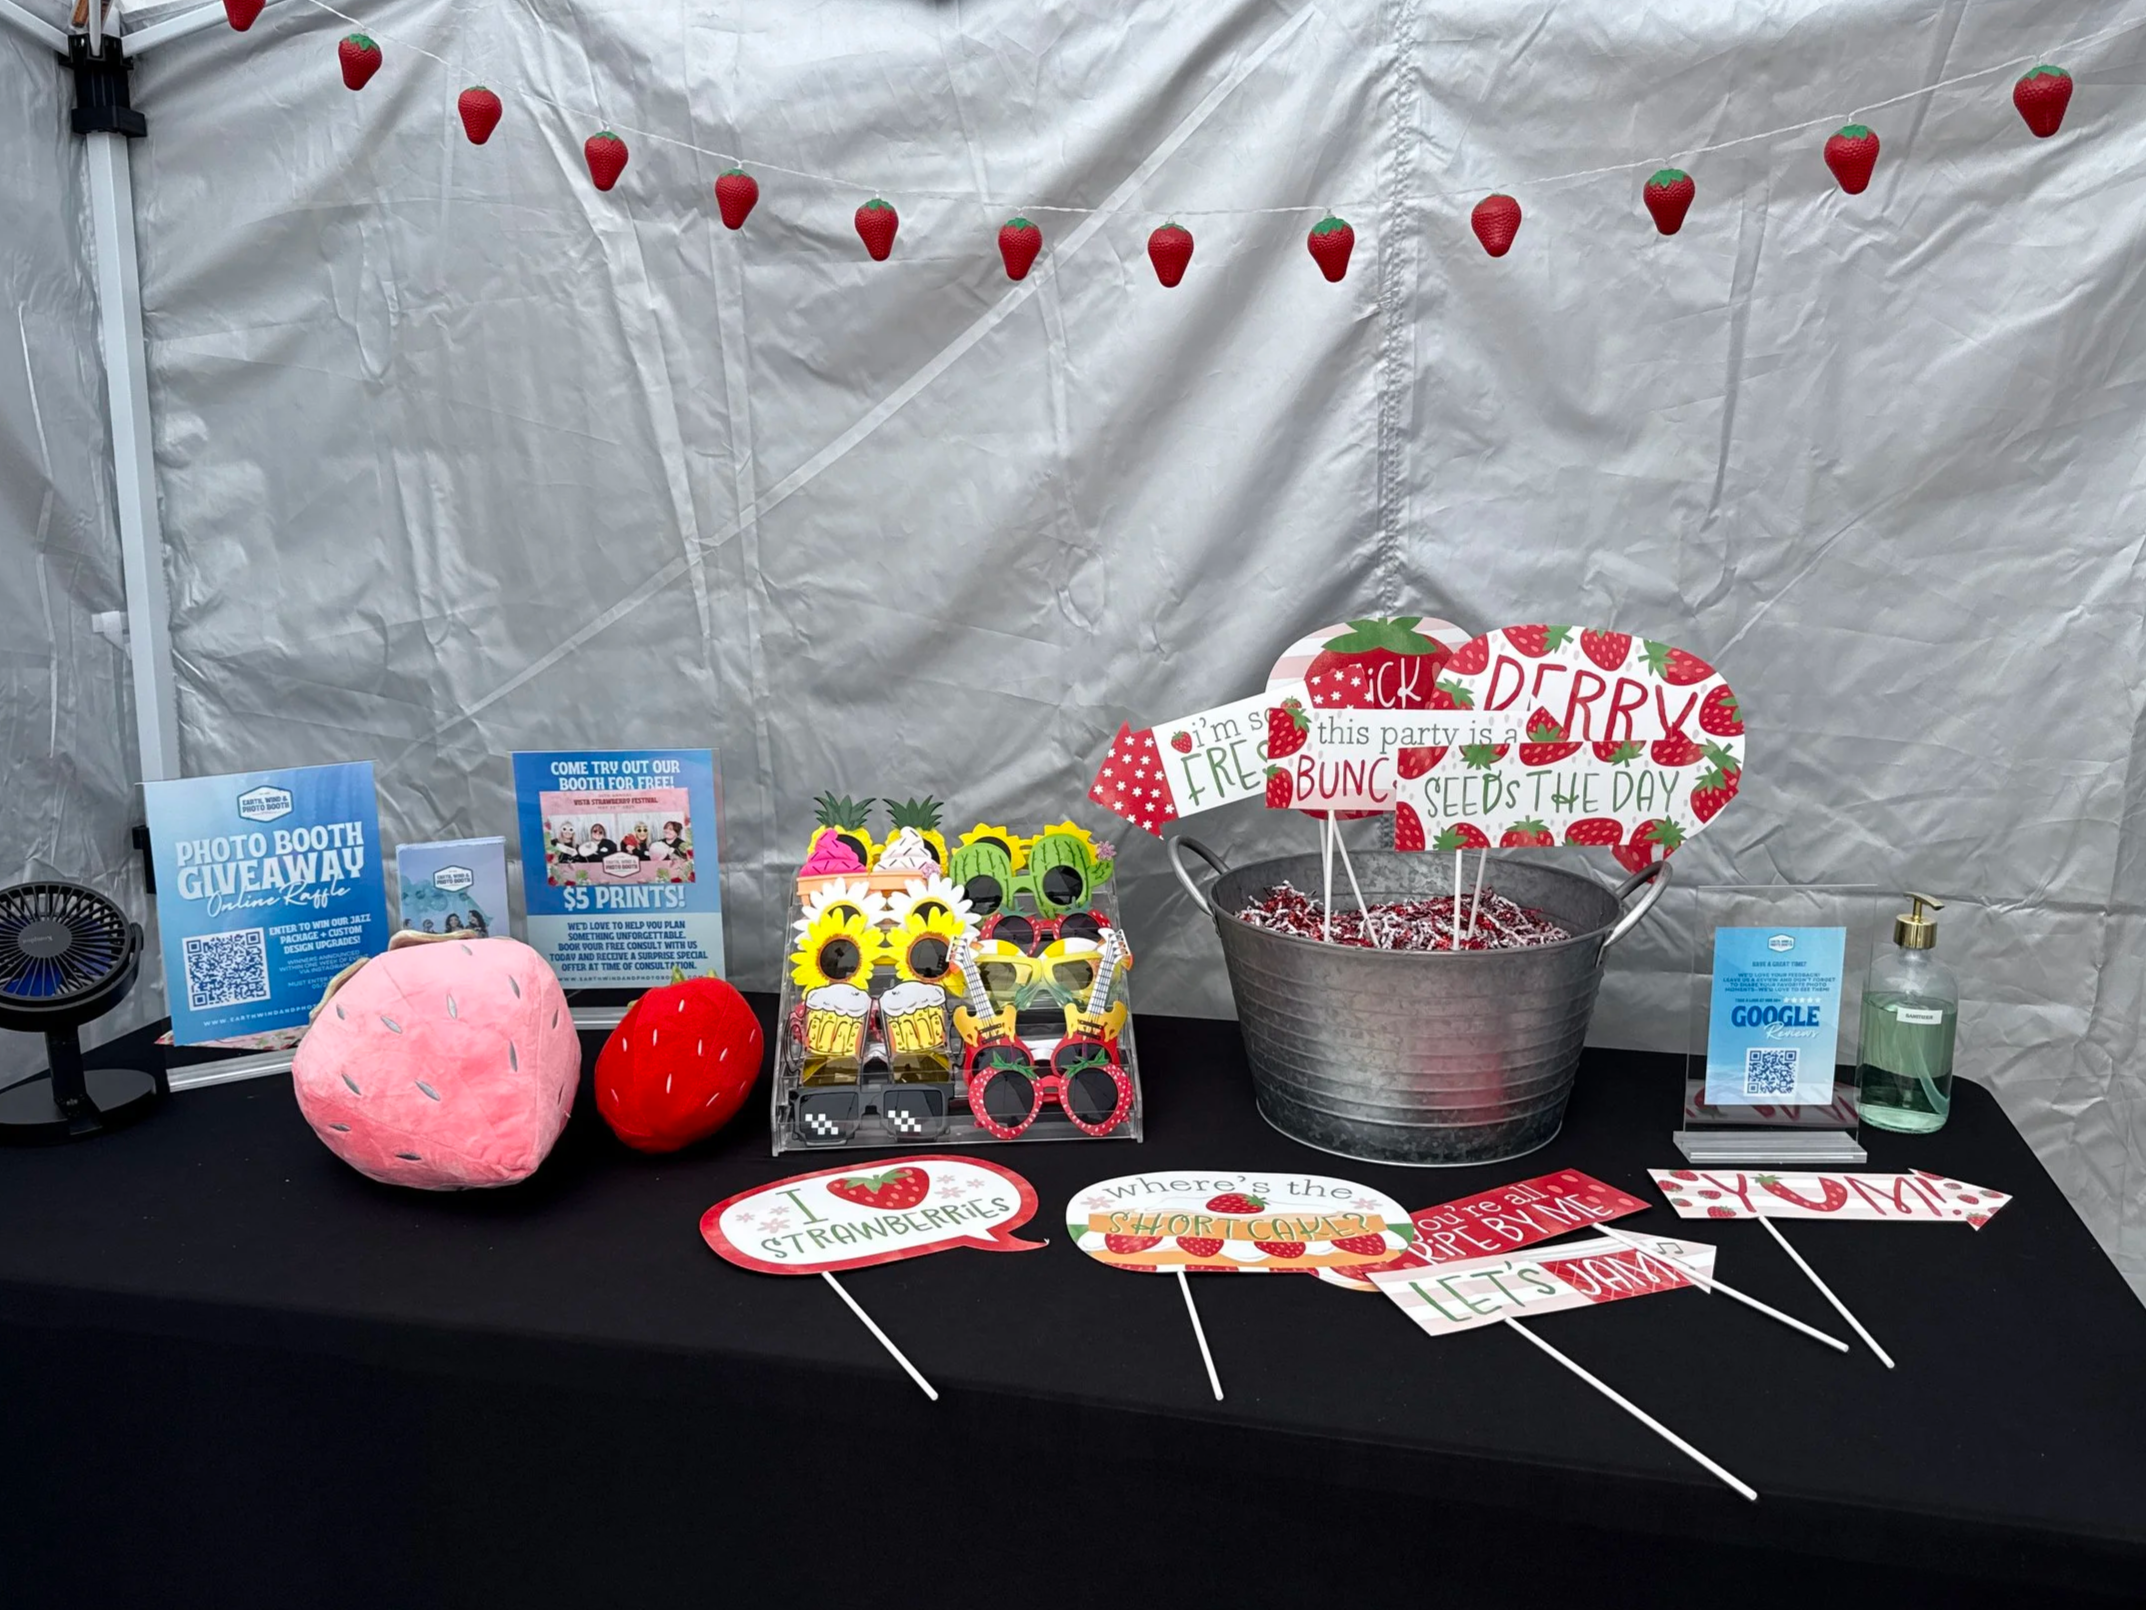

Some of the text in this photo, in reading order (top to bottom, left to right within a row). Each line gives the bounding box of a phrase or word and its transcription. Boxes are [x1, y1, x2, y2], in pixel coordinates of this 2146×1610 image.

[1368, 656, 1422, 709] iCK
[1484, 654, 1698, 743] RRY
[1191, 717, 1242, 749] i'm
[1317, 716, 1517, 755] this party is a
[550, 759, 680, 776] COME TRY OUT OUR
[1181, 739, 1269, 806] FRE
[1296, 754, 1397, 803] BUNC
[558, 775, 674, 791] BOOTH FOR FREE!
[1526, 770, 1600, 814] THE
[1613, 770, 1680, 813] DAY
[242, 802, 290, 813] PHOTO BOOTH
[175, 821, 365, 867] PHOTO BOOTH
[177, 846, 365, 900] GIVEAWAY
[206, 874, 351, 918] Online Raffle
[563, 884, 687, 911] $5 PRINTS!
[269, 913, 372, 936] ENTER TO WIN OUR JAZZ
[280, 931, 319, 945] PACKAGE
[328, 925, 363, 938] CUSTOM
[567, 920, 686, 931] WE'D LOVE TO HELP YOU PLAN
[568, 930, 687, 941] SOMETHING UNFORGETTABLE.
[283, 935, 361, 954] DESIGN UPGRADES!
[549, 950, 708, 962] TODAY AND RECEIVE A SURPRISE SPECIAL
[558, 940, 698, 951] BOOK YOUR FREE CONSULT WITH US
[561, 960, 697, 972] OFFER AT TIME OF CONSULTATION.
[1731, 1005, 1820, 1028] GOOGLE
[1764, 1021, 1819, 1040] Reviews
[1102, 1175, 1354, 1200] where's the
[1504, 1183, 1550, 1206] all
[1701, 1173, 1963, 1216] YUM!
[776, 1188, 829, 1225] I
[1481, 1208, 1549, 1243] BY
[1531, 1193, 1614, 1228] ME
[1408, 1260, 1557, 1323] LET'S
